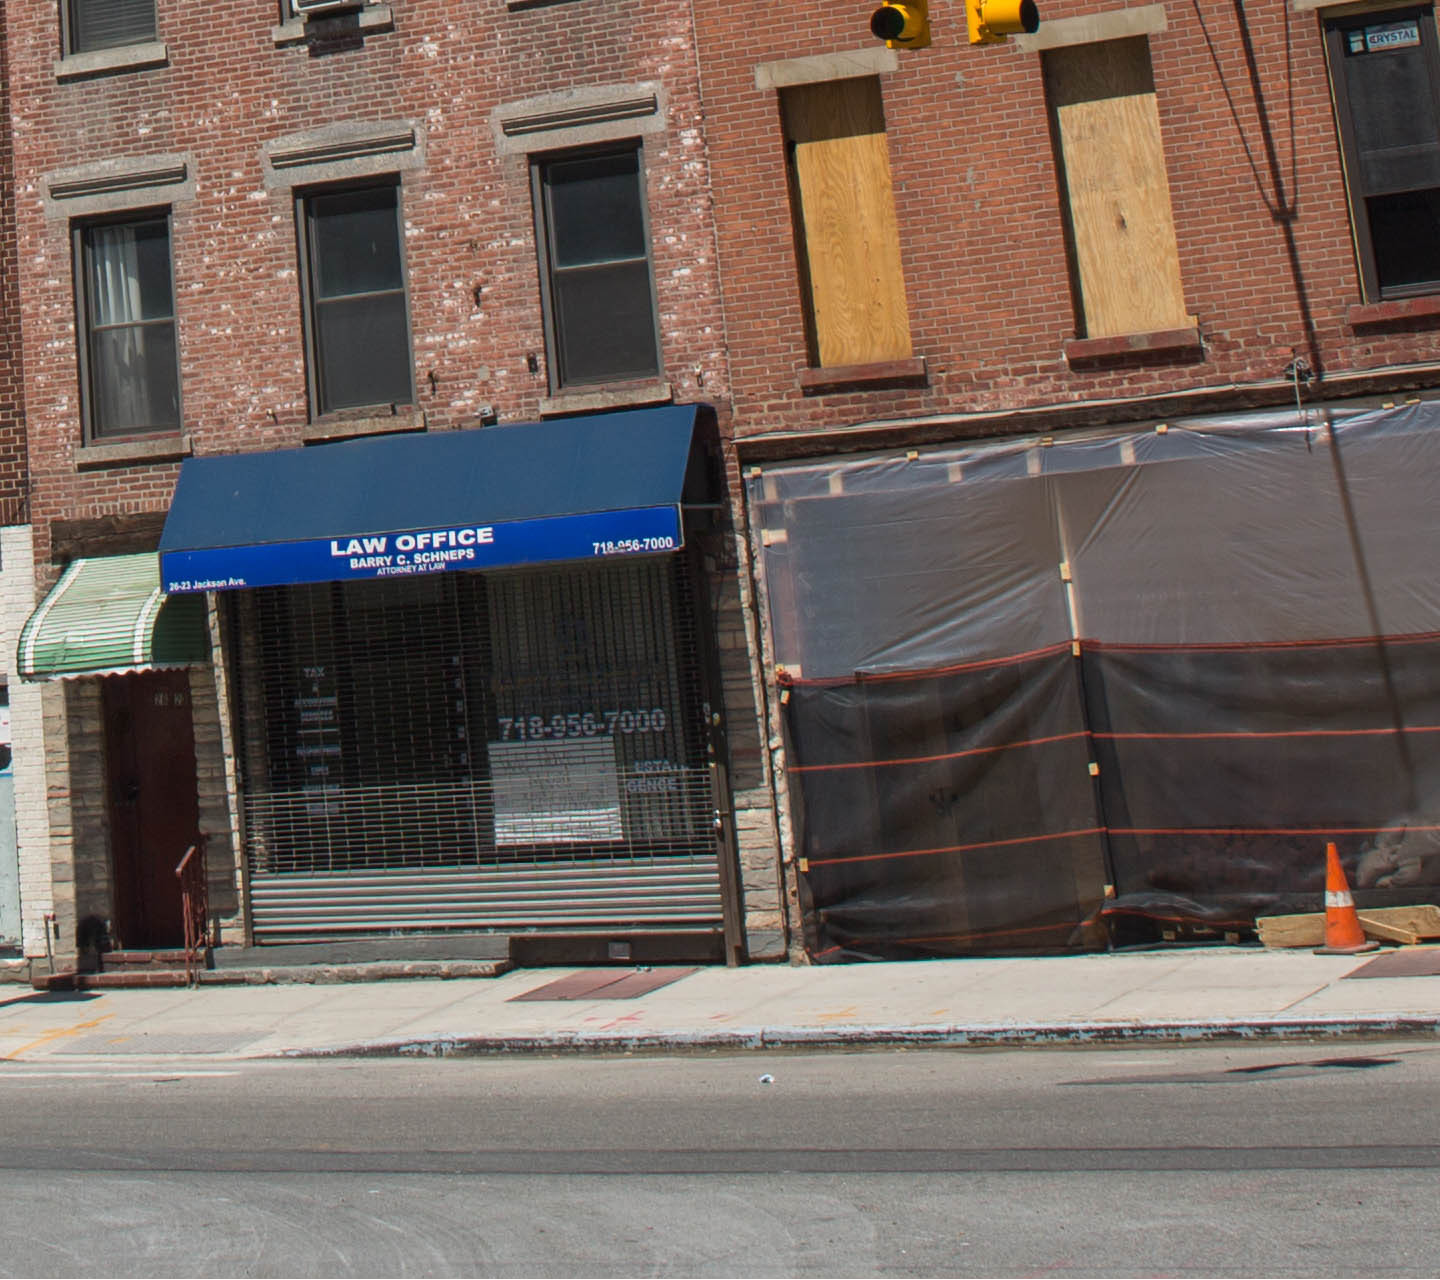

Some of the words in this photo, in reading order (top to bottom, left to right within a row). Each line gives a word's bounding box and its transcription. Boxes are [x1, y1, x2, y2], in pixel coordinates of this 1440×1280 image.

[330, 537, 387, 557] LAW
[395, 527, 495, 551] OFFICE
[592, 536, 674, 555] 718-956-7000
[350, 555, 393, 569] BARRY
[396, 554, 411, 565] C.
[413, 548, 475, 564] SCHNEPS
[376, 564, 417, 576] ATTORNEY
[418, 562, 428, 572] AT
[428, 561, 446, 572] LAW
[169, 581, 192, 592] 26-23
[192, 578, 227, 590] Jackson
[228, 576, 247, 587] Ave.
[497, 708, 667, 740] 718-956-7000
